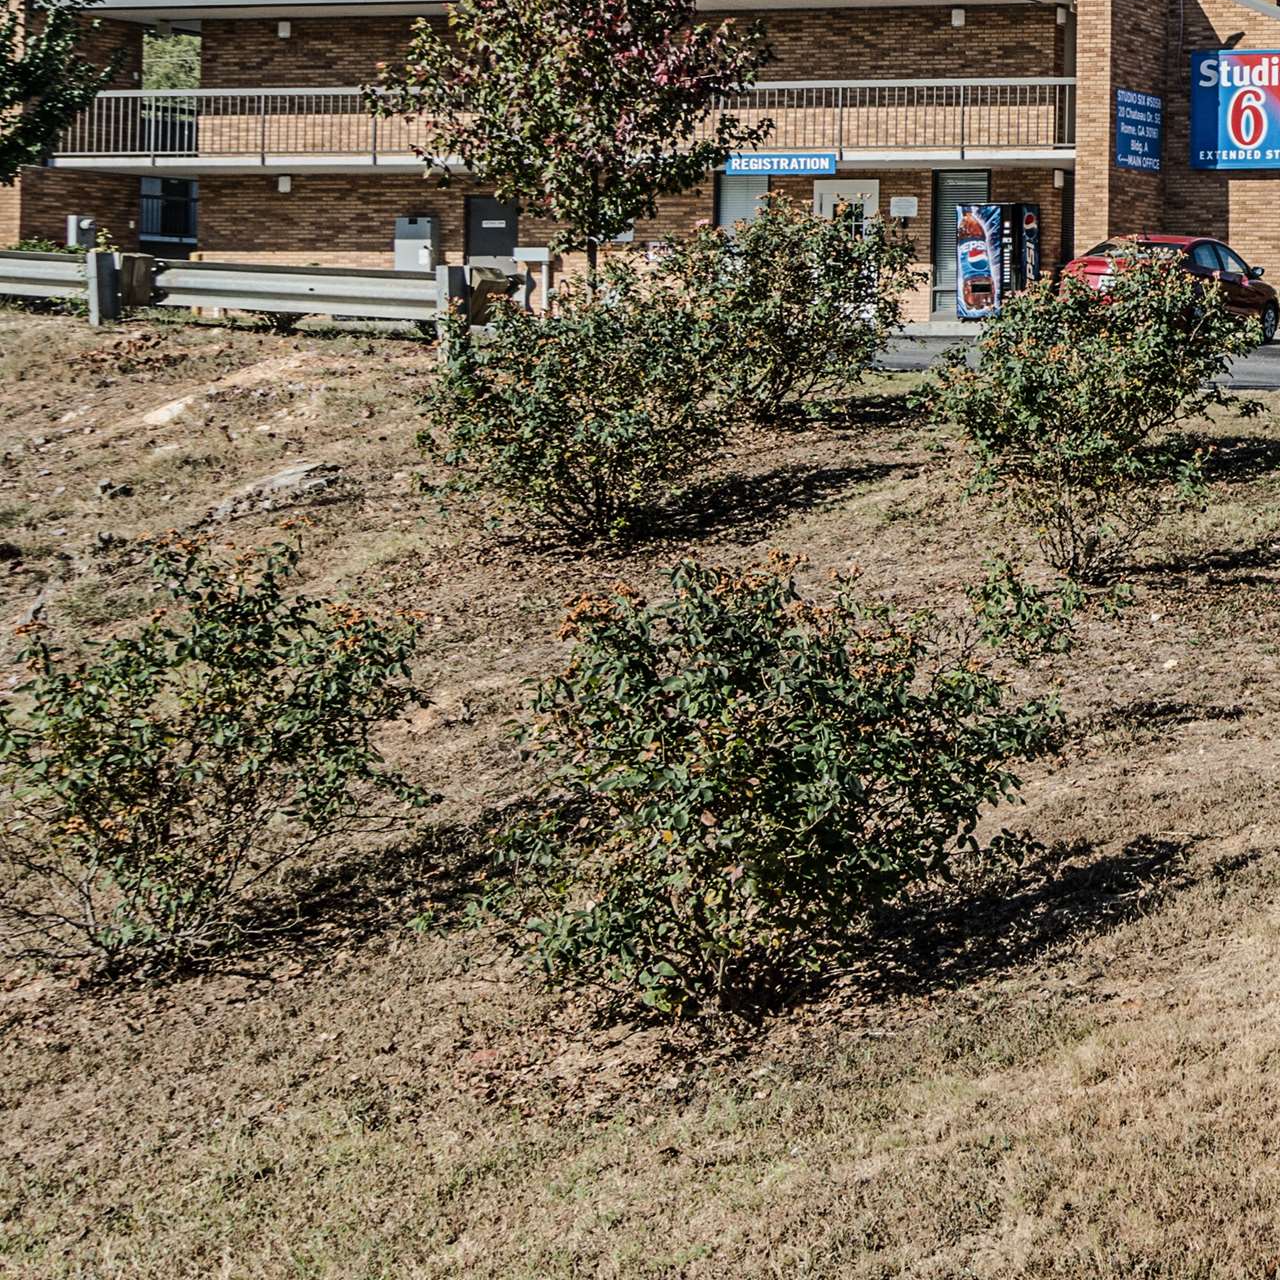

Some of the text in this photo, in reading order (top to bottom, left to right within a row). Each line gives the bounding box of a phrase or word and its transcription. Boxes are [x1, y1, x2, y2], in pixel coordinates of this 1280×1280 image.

[1117, 90, 1137, 104] STUDIO
[1137, 94, 1146, 106] SIX
[1228, 87, 1267, 149] 6
[1143, 141, 1149, 153] A
[1199, 149, 1262, 160] EXTENDED
[731, 157, 830, 170] REGISTRATION
[1127, 154, 1160, 170] MAIN OFFICE
